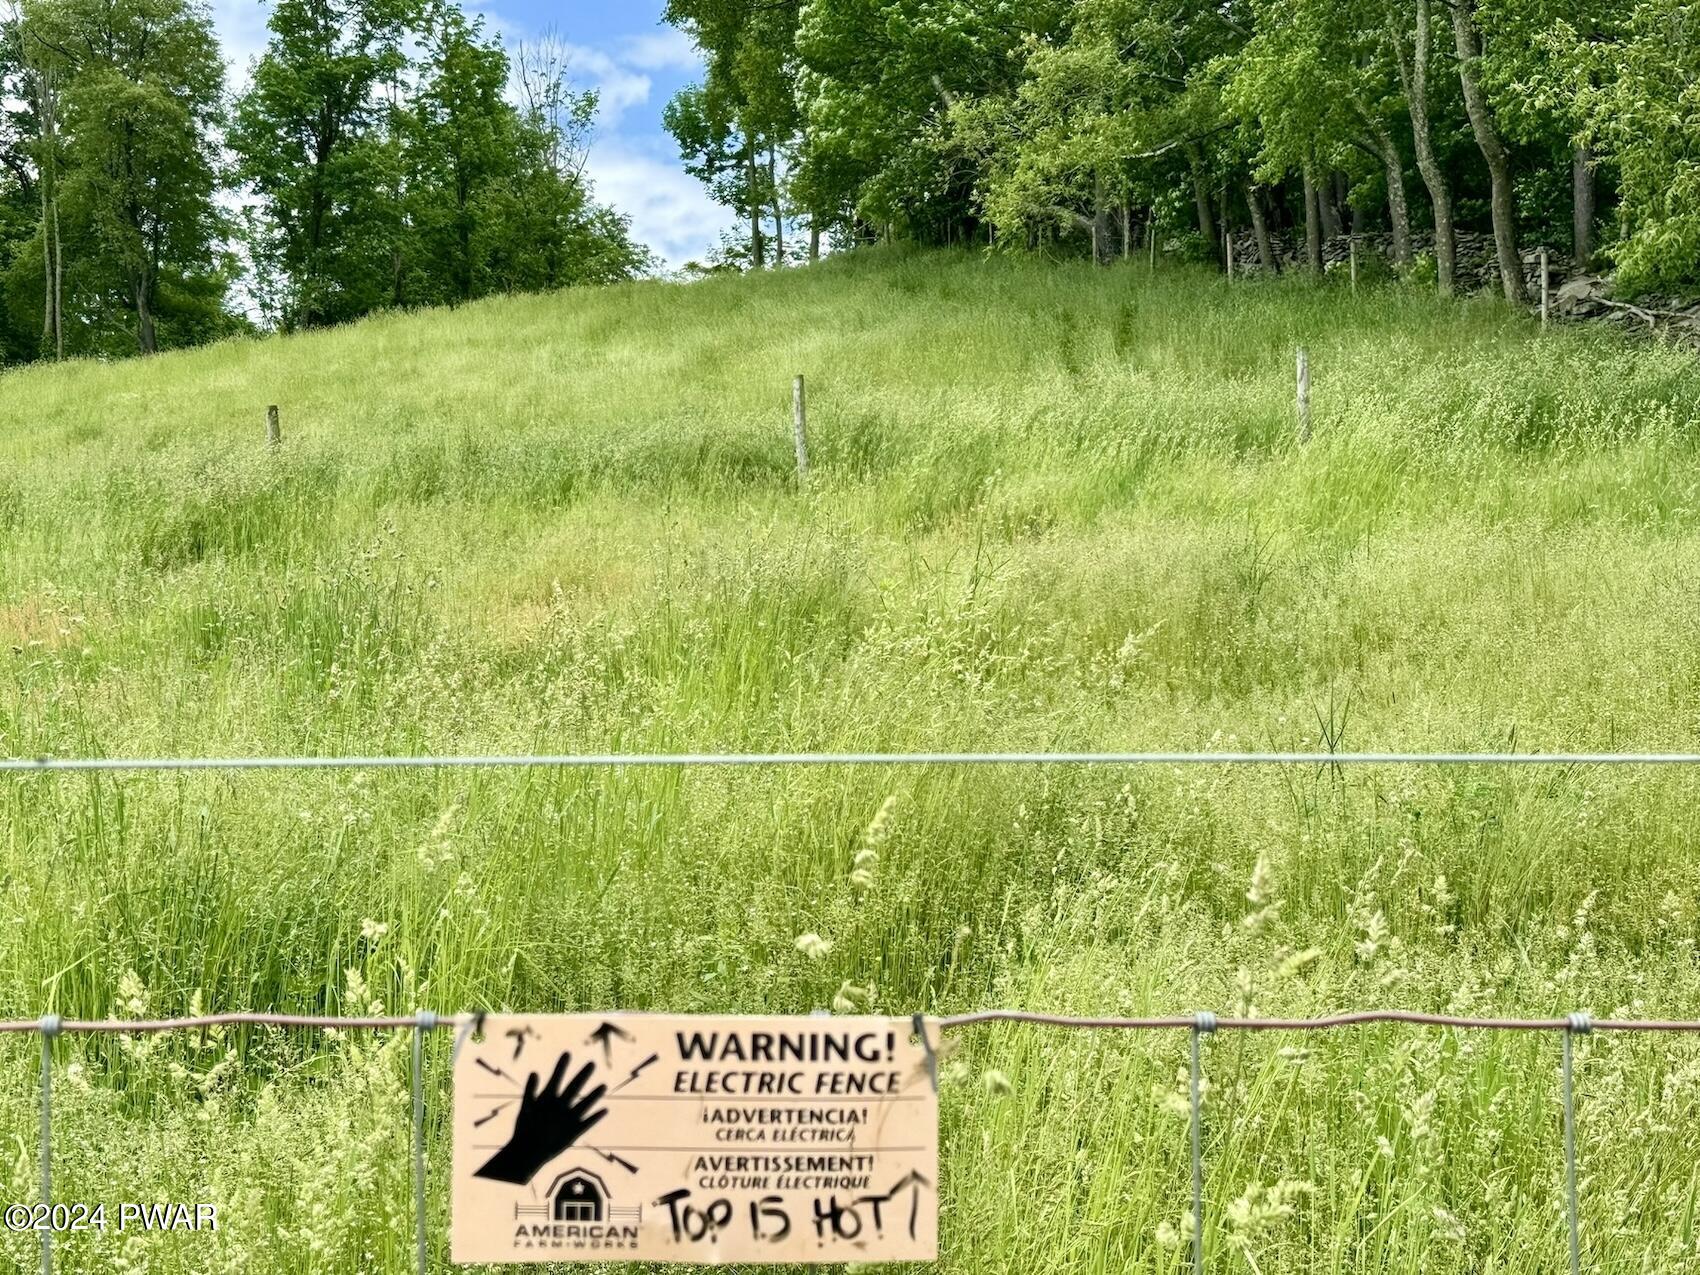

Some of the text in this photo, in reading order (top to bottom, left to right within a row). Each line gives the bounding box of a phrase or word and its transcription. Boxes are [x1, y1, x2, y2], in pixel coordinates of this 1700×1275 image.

[676, 1032, 895, 1062] WARNING!
[674, 1070, 901, 1095] ELECTRIC FENCE
[715, 1127, 766, 1142] CERCA
[694, 1155, 874, 1172] AVERTISSEMENT!
[655, 1188, 733, 1244] TOP
[514, 1224, 638, 1239] AMERICAN
